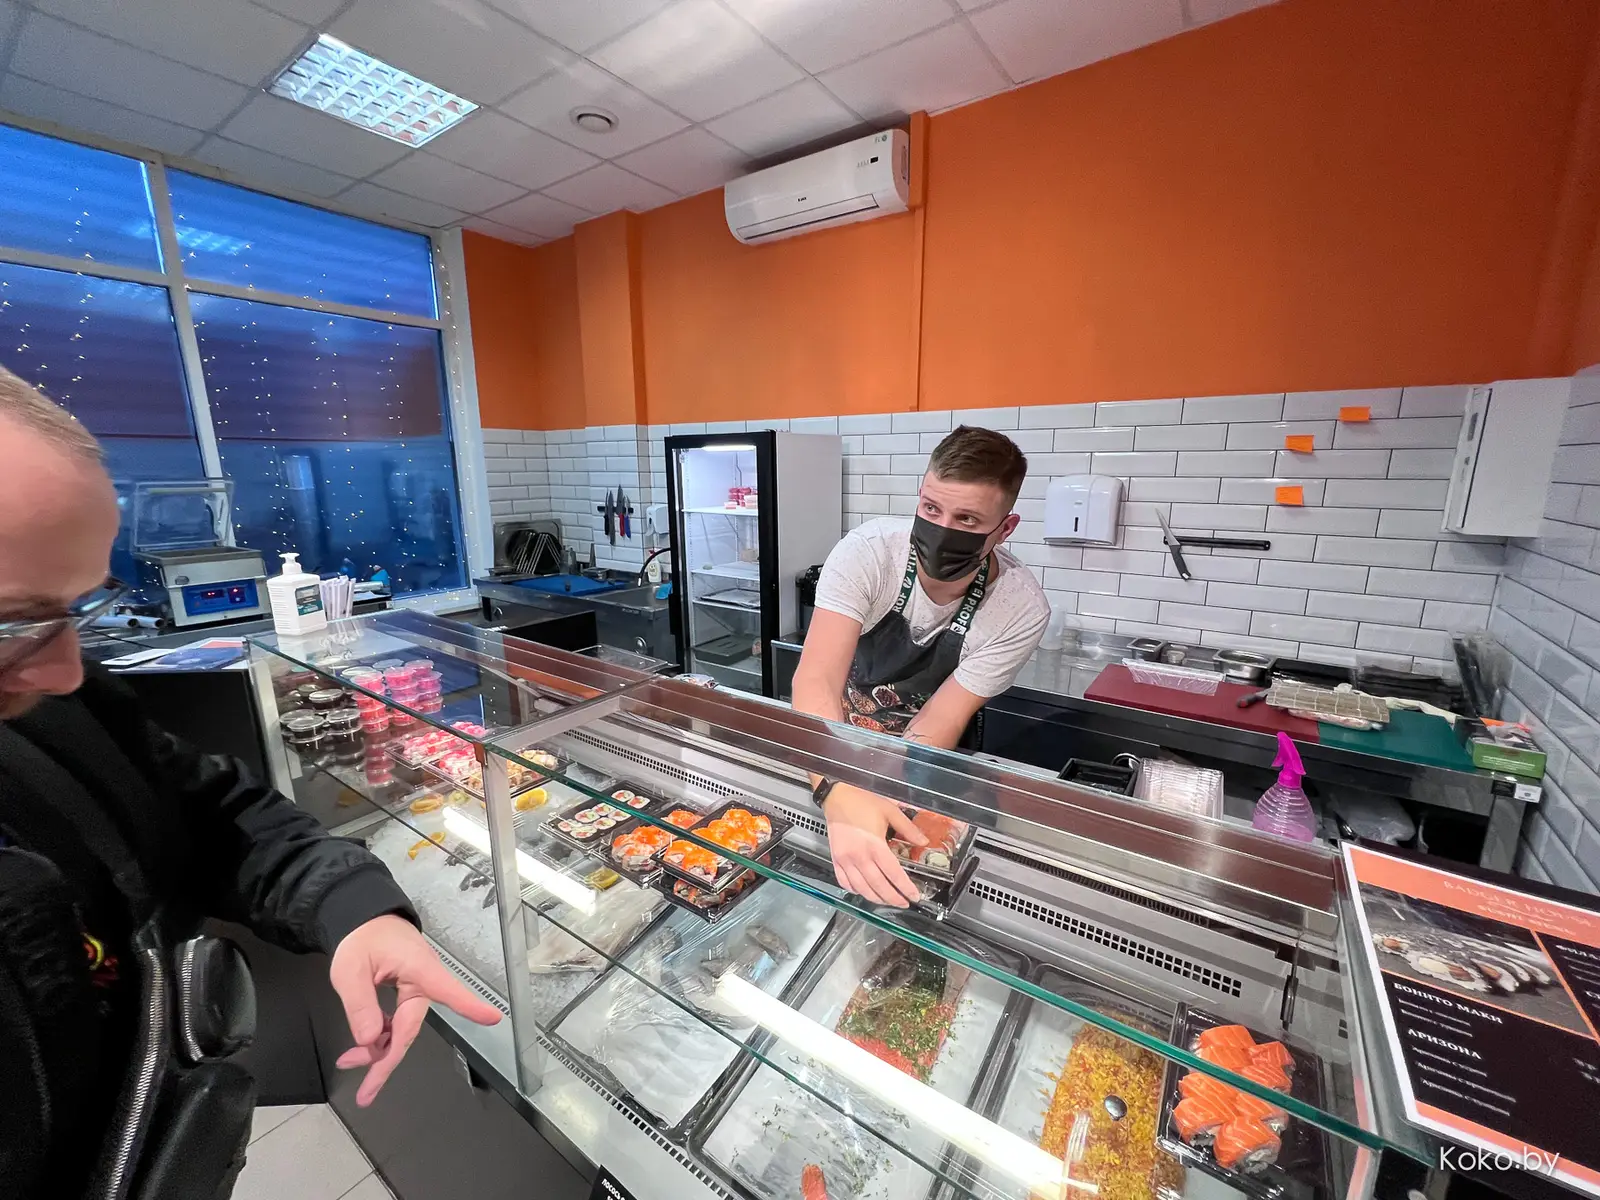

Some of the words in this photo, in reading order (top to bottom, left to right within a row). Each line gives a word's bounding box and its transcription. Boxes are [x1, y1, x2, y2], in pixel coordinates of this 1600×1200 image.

[892, 591, 908, 613] ROF
[957, 597, 978, 627] PROF
[1393, 982, 1453, 1007] БОНИТО
[1457, 1003, 1503, 1025] МАКИ
[1408, 1028, 1482, 1060] АРИЗОНА
